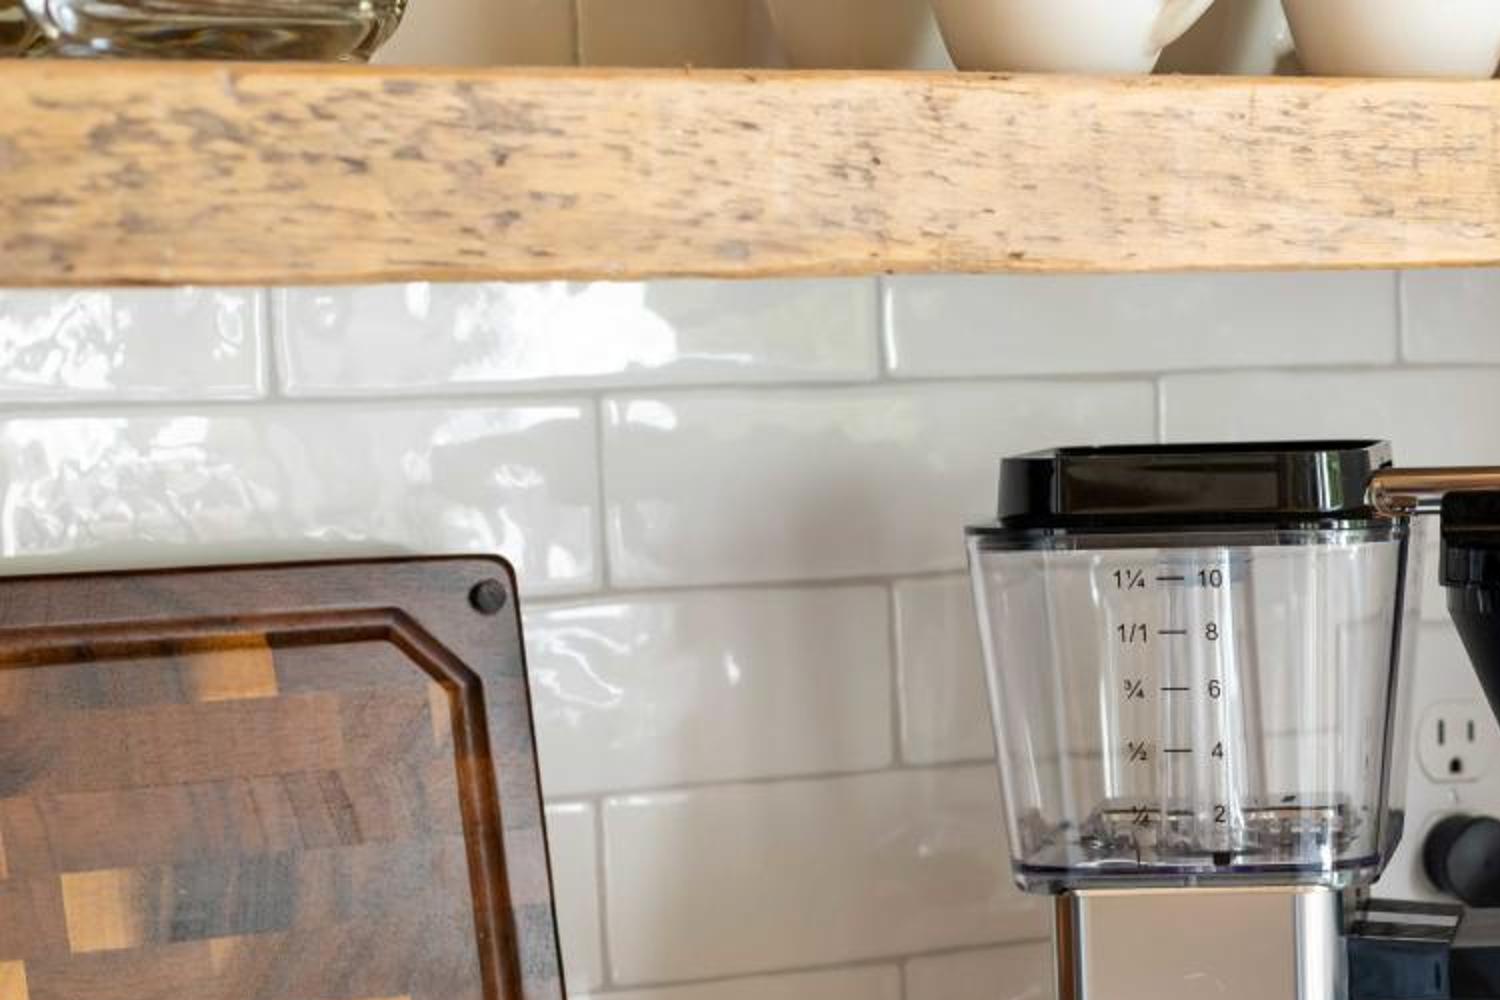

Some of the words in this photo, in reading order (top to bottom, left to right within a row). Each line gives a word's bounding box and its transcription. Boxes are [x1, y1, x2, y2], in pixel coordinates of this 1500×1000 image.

[1198, 569, 1223, 588] 10
[1117, 623, 1148, 643] 1/1
[1205, 622, 1219, 641] 8
[1208, 679, 1221, 699] 6
[1211, 741, 1223, 759] 4
[1214, 805, 1226, 823] 2
